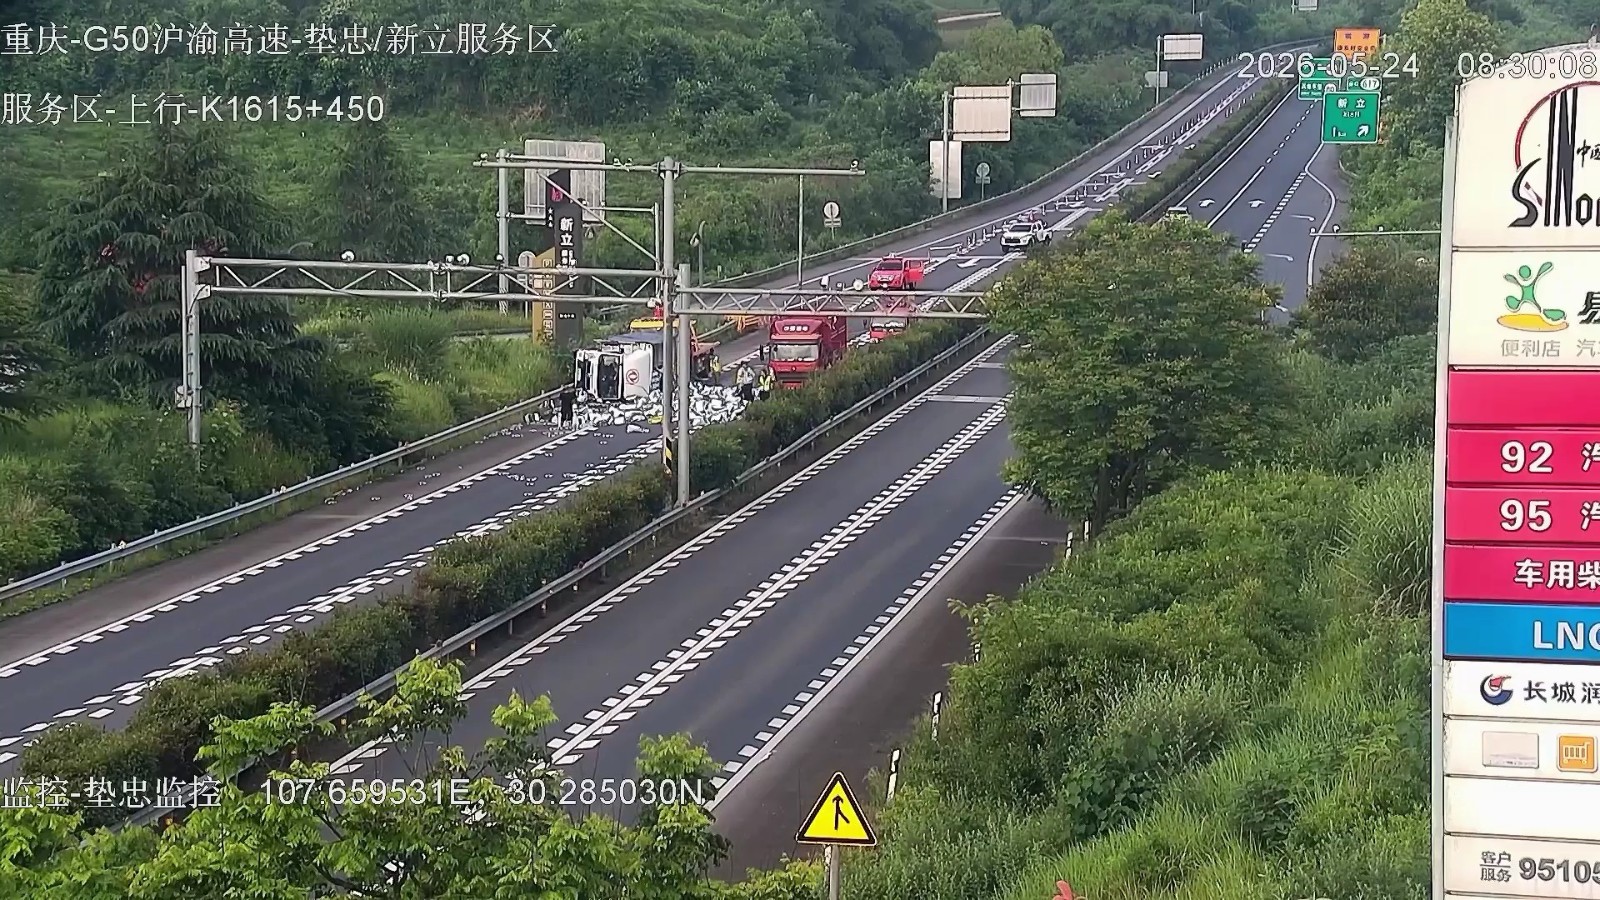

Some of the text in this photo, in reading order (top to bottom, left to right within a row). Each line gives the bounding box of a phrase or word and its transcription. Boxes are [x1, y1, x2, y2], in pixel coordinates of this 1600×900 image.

[1500, 339, 1600, 359] 便利店 汽
[1500, 441, 1553, 474] 92
[1499, 499, 1552, 532] 95
[1481, 851, 1512, 867] 客户
[1480, 867, 1512, 883] 服务
